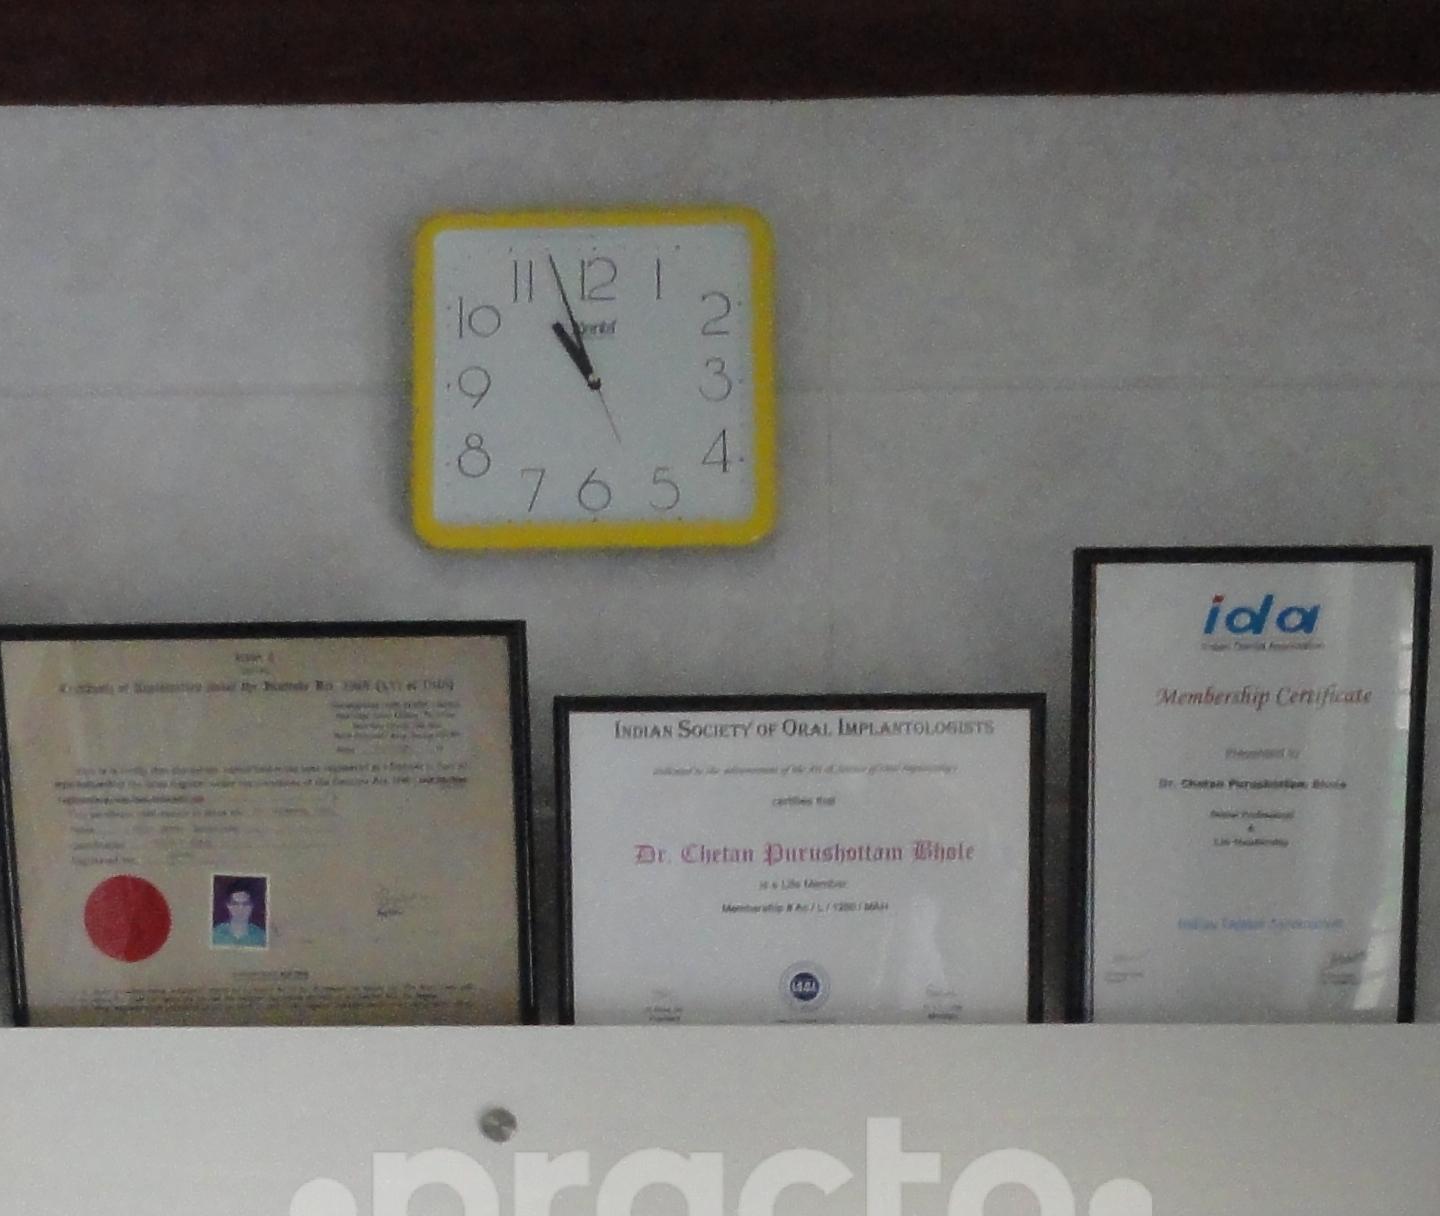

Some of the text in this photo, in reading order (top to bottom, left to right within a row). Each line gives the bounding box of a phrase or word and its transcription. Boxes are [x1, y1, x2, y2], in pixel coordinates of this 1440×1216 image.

[512, 259, 534, 303] 11
[579, 256, 618, 301] 12
[654, 257, 662, 301] 1
[458, 296, 502, 339] 10
[701, 290, 732, 336] 2
[458, 365, 492, 408] 9
[698, 356, 733, 402] 3
[458, 432, 492, 478] 8
[701, 428, 732, 473] 4
[520, 467, 546, 512] 7
[578, 467, 612, 511] 6
[649, 466, 681, 511] 5
[1203, 594, 1321, 635] ida
[1157, 683, 1373, 711] Membership Certificate
[680, 842, 755, 867] Chetan
[762, 840, 904, 867] Purushottam
[911, 838, 976, 865] Bhole
